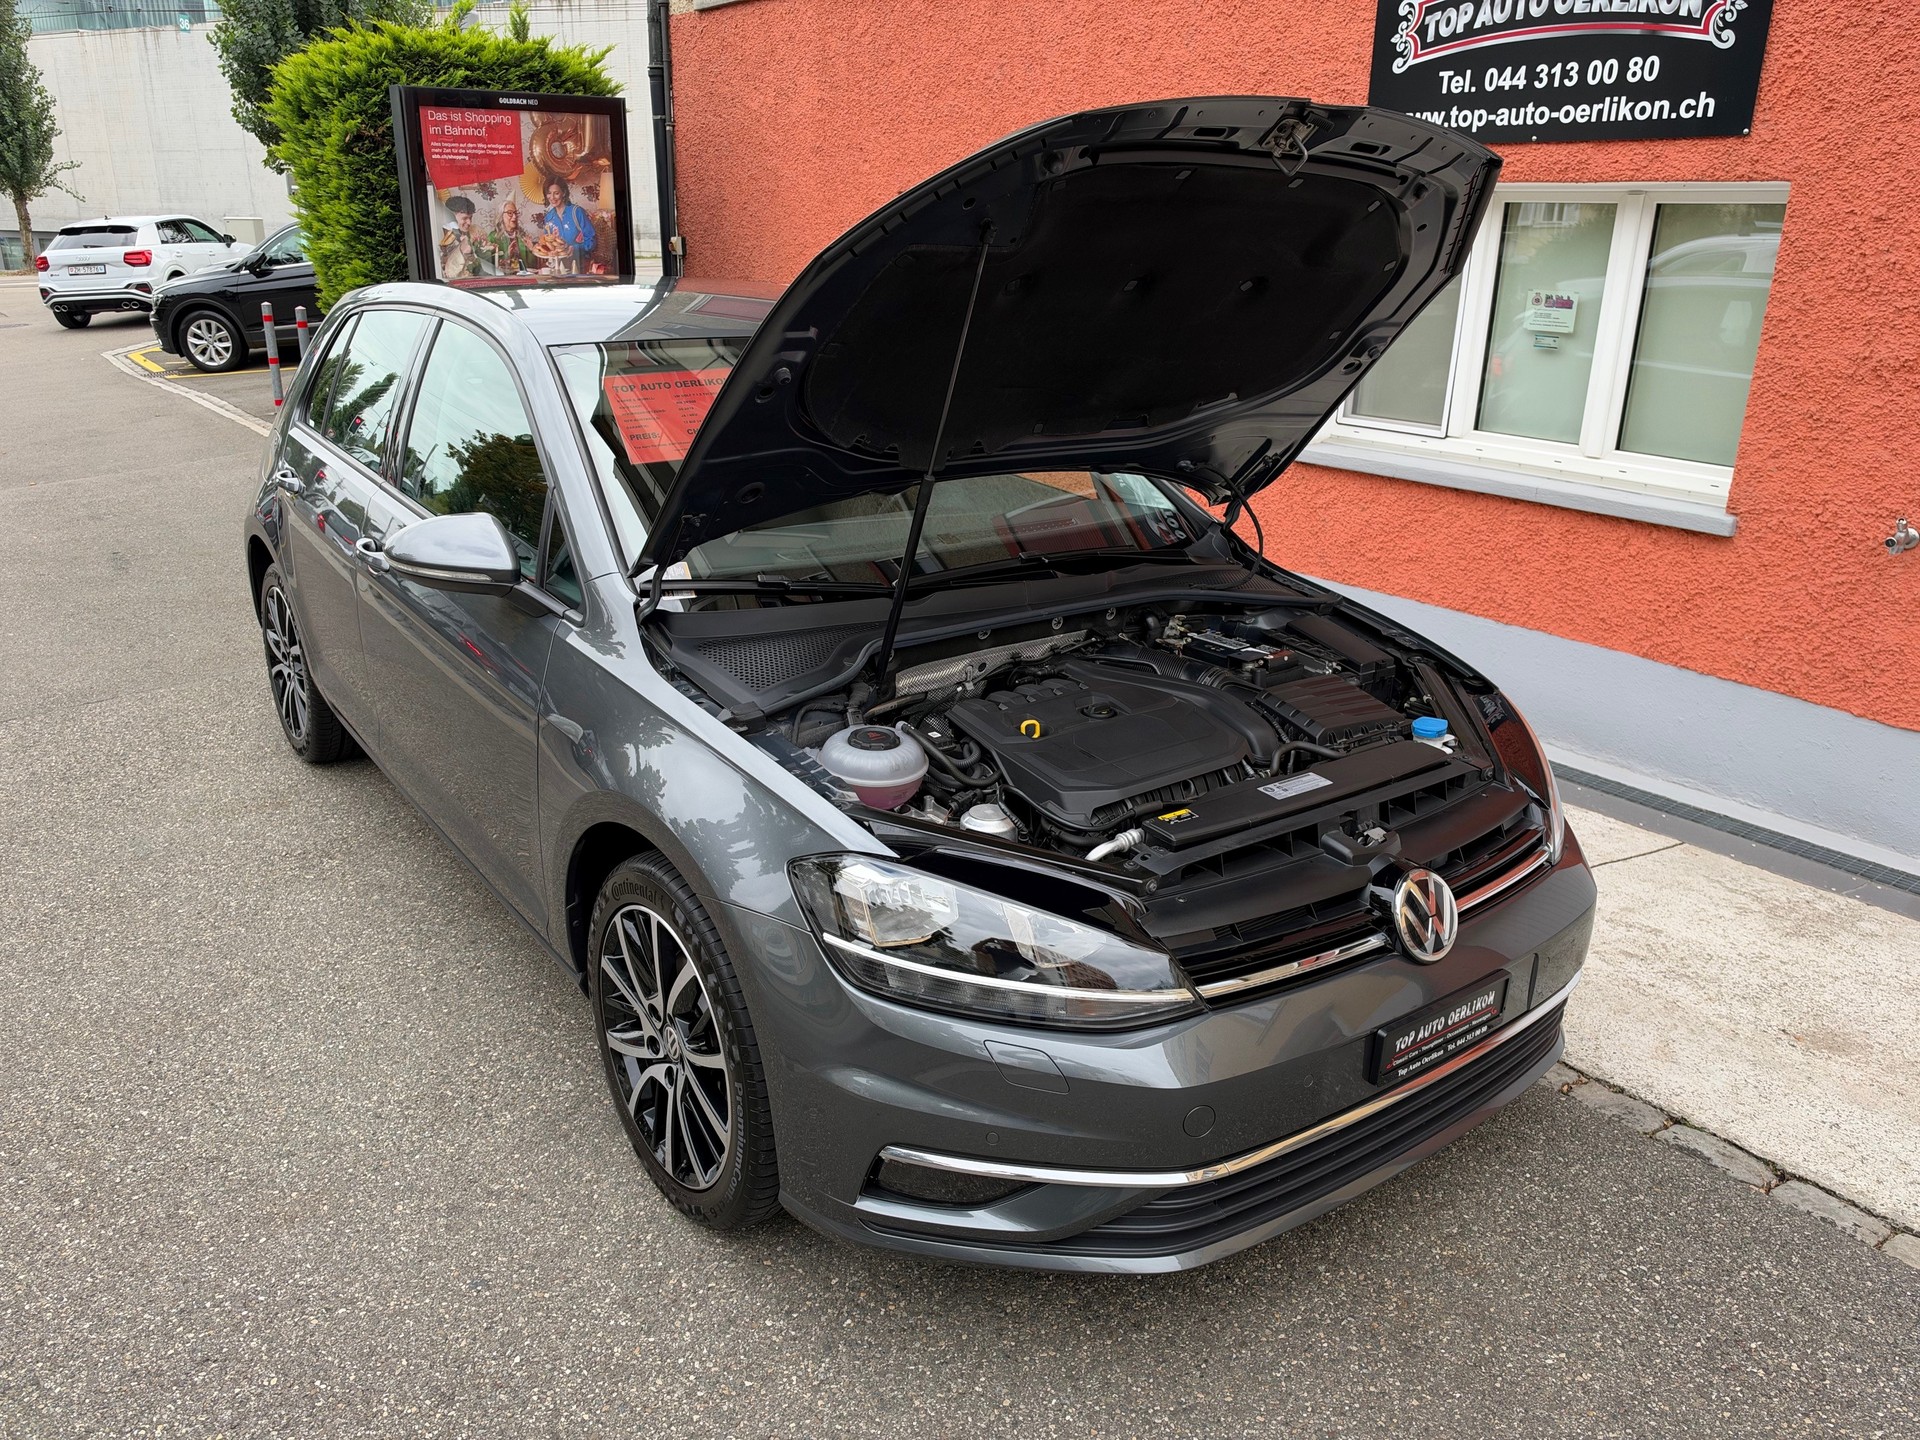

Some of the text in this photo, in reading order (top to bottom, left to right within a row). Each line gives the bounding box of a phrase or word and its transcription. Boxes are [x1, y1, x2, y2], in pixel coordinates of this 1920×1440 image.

[179, 18, 190, 30] 36
[1425, 2, 1475, 43] TOP
[1473, 0, 1549, 30] AUTO
[1439, 55, 1660, 95] Tel. 044 313 00 80
[499, 97, 539, 106] GOLDBACH NEO
[428, 110, 512, 126] Das ist Shopping
[1406, 92, 1716, 133] w.top-auto-oerlikon.ch
[429, 124, 488, 137] im Bahnhof.
[613, 377, 727, 393] TOP AUTO OERLIKO
[629, 432, 661, 441] PREIS:
[1395, 990, 1496, 1052] TOP AUTO OERLIKON
[1397, 1067, 1408, 1077] Top
[1408, 1060, 1421, 1072] Auto
[1421, 1049, 1444, 1065] Oerlikon
[1447, 1043, 1456, 1051] Tel.
[1456, 1037, 1466, 1047] 044
[1474, 1028, 1482, 1037] 00
